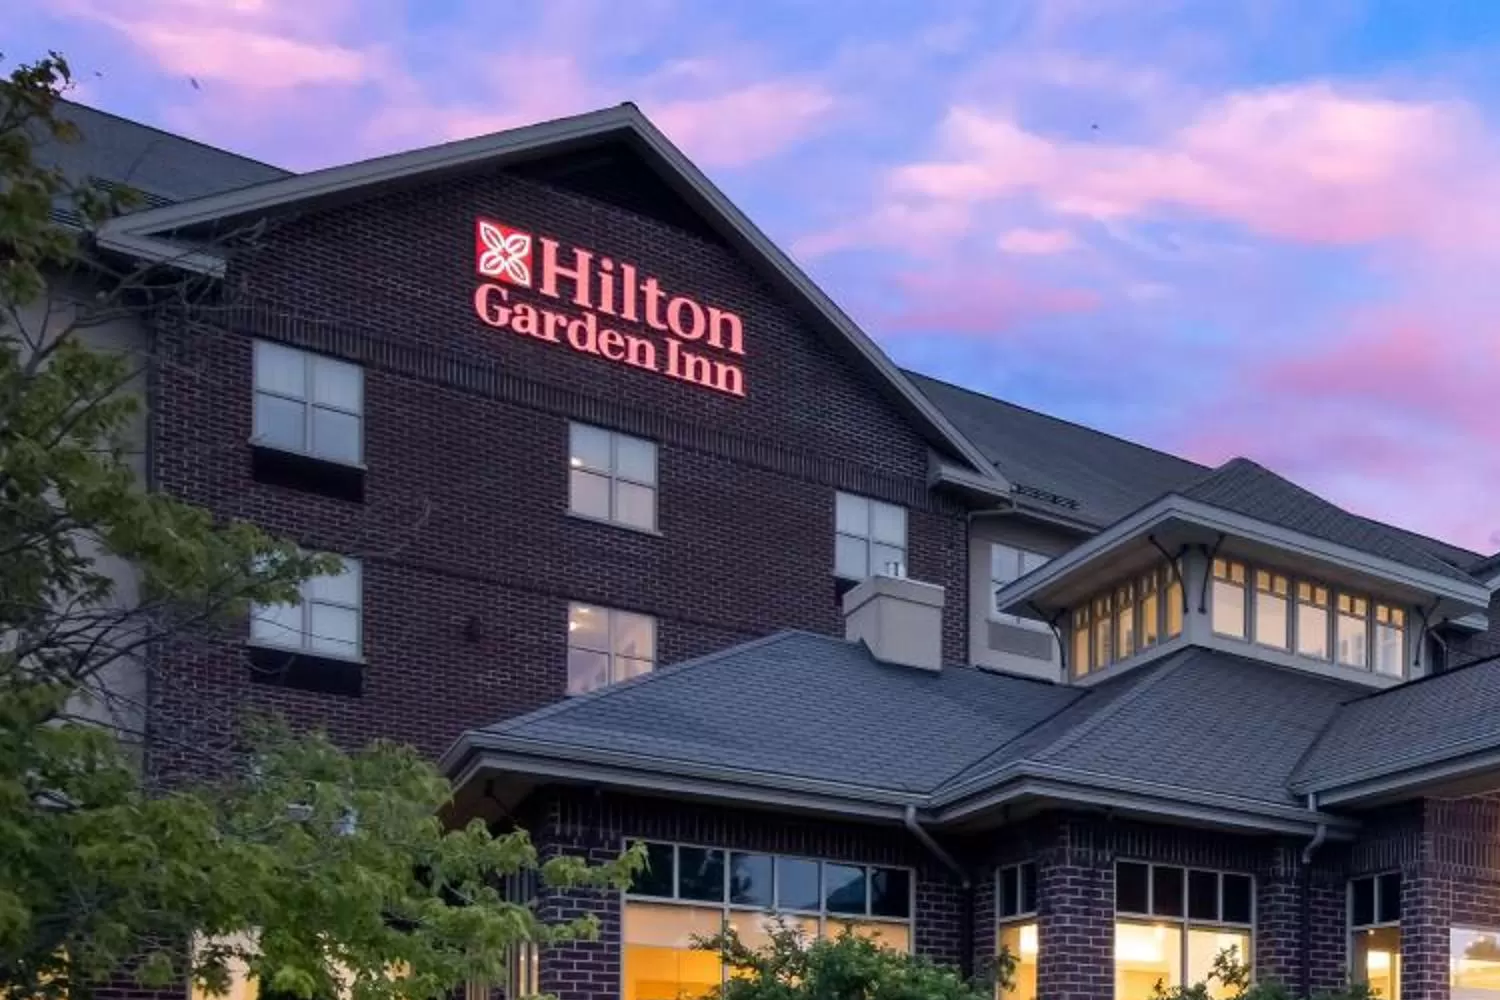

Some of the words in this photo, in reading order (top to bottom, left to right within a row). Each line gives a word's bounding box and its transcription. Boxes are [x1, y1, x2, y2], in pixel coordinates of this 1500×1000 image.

[474, 283, 659, 371] Garden
[665, 337, 745, 397] Inn
[539, 237, 745, 354] Hilton
